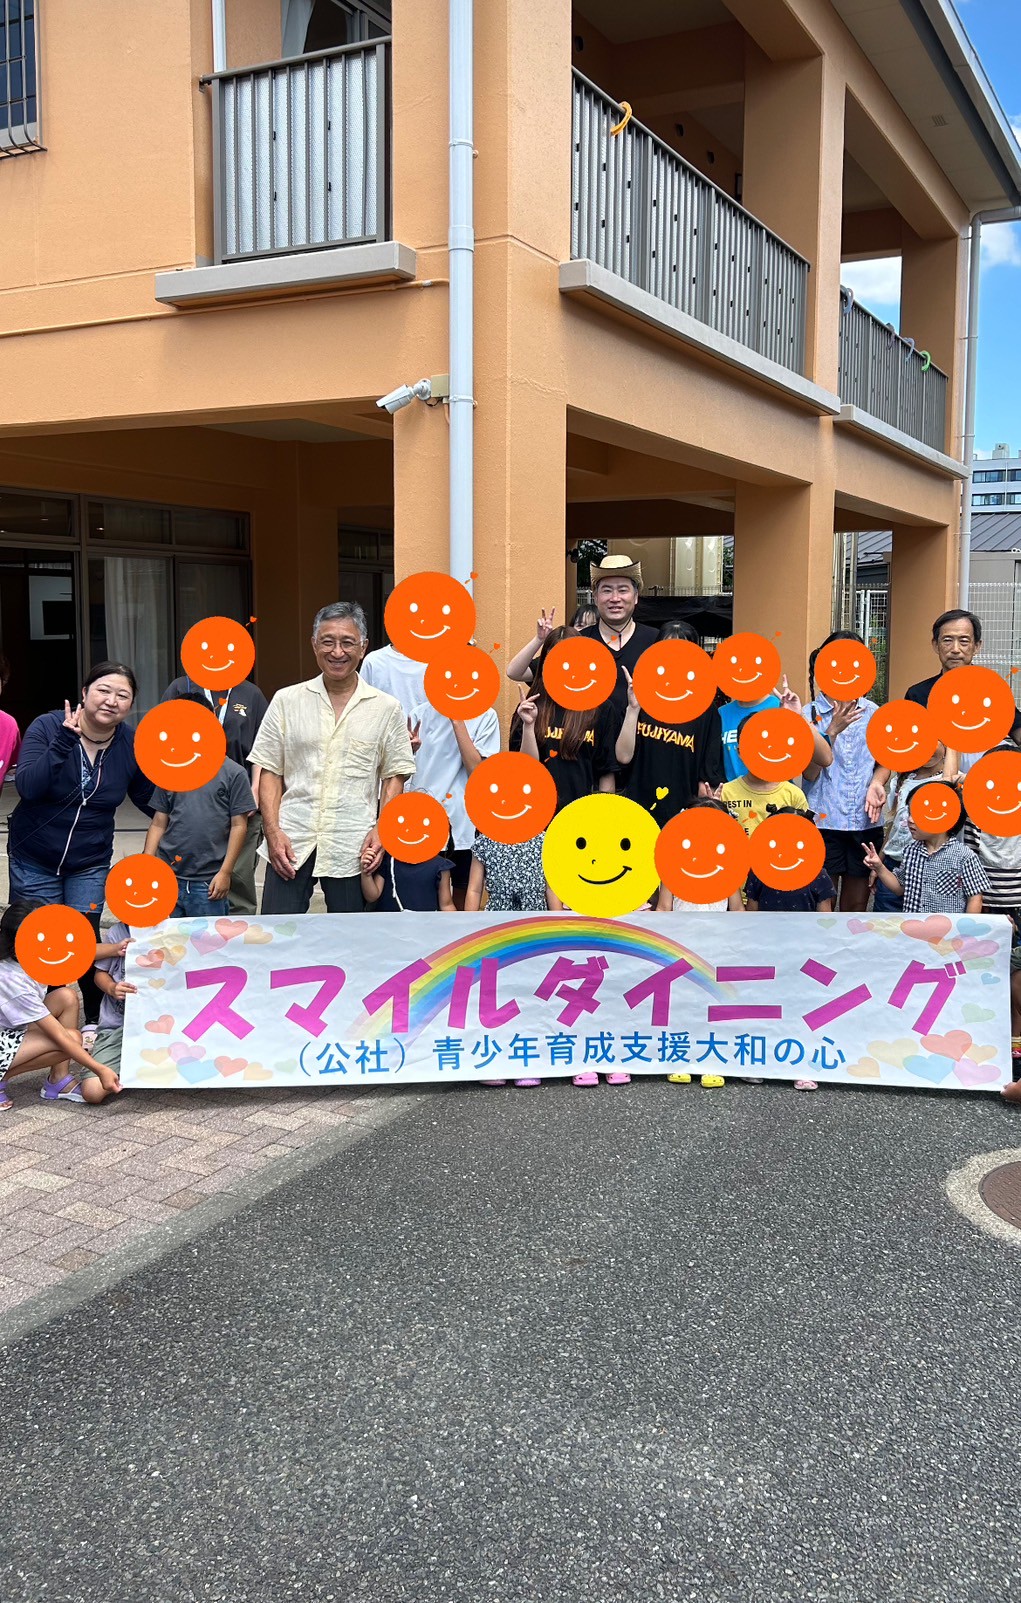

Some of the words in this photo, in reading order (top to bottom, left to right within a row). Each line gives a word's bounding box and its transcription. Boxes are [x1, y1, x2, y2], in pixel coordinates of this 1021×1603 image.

[637, 721, 695, 753] FUJIYAMA
[743, 800, 753, 808] IN
[181, 955, 967, 1043] スマイルダイニング
